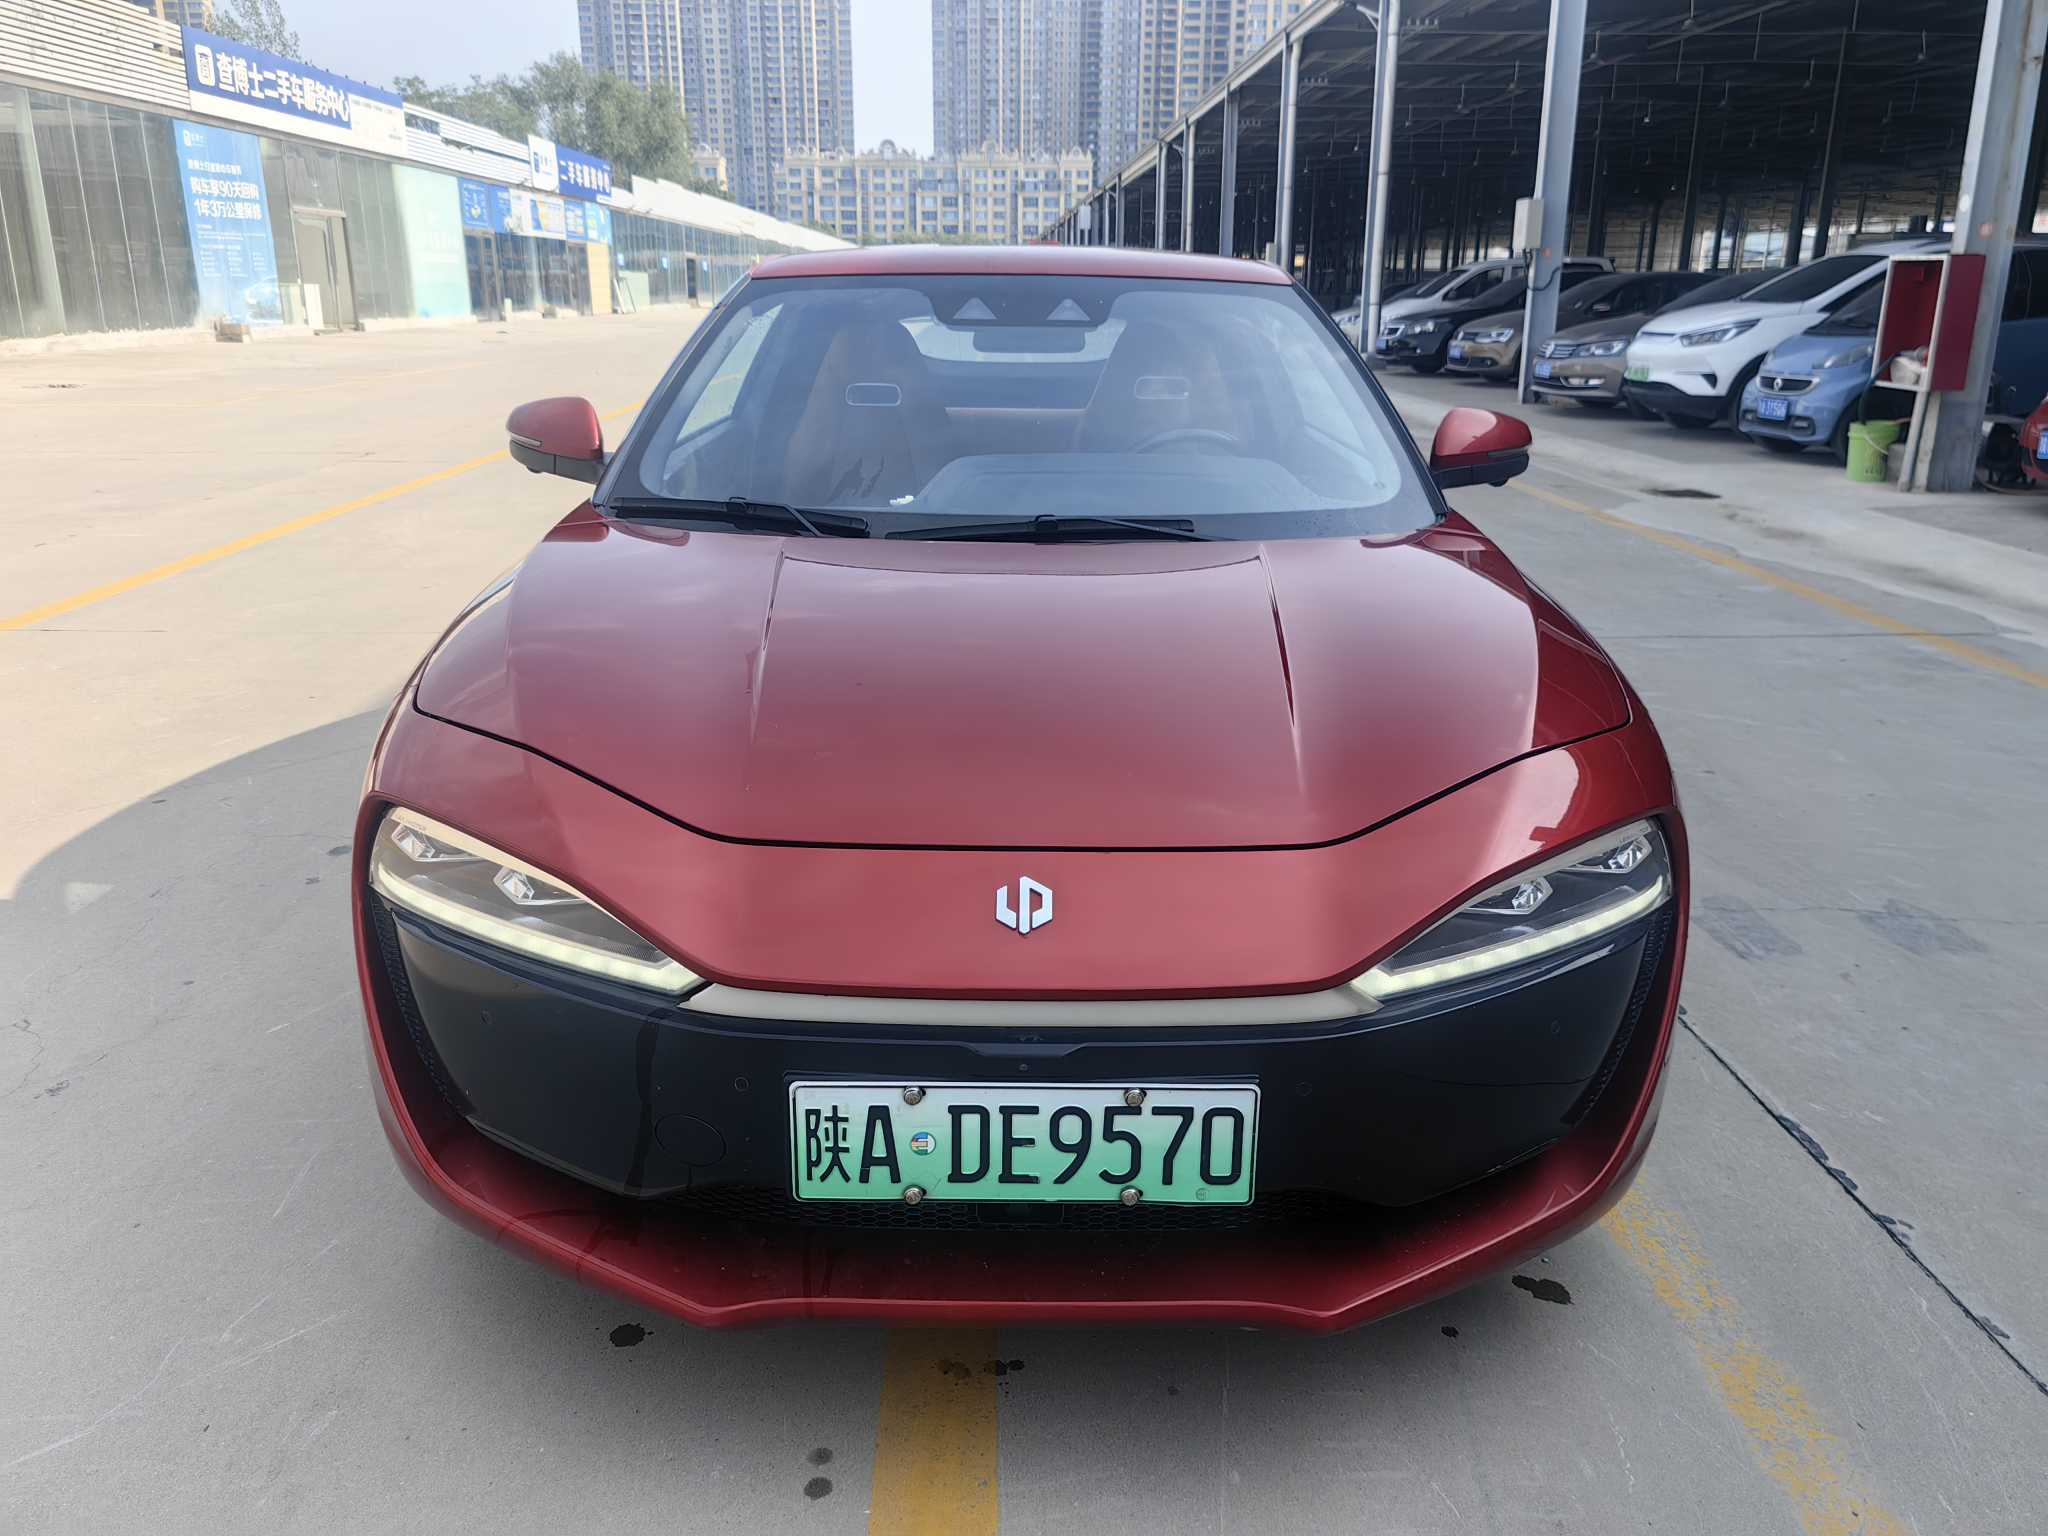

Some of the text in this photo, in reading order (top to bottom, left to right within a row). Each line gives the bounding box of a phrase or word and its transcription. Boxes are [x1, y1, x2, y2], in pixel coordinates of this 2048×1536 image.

[215, 51, 351, 122] 查博士二手车服务中心
[947, 1104, 1246, 1187] DE9570
